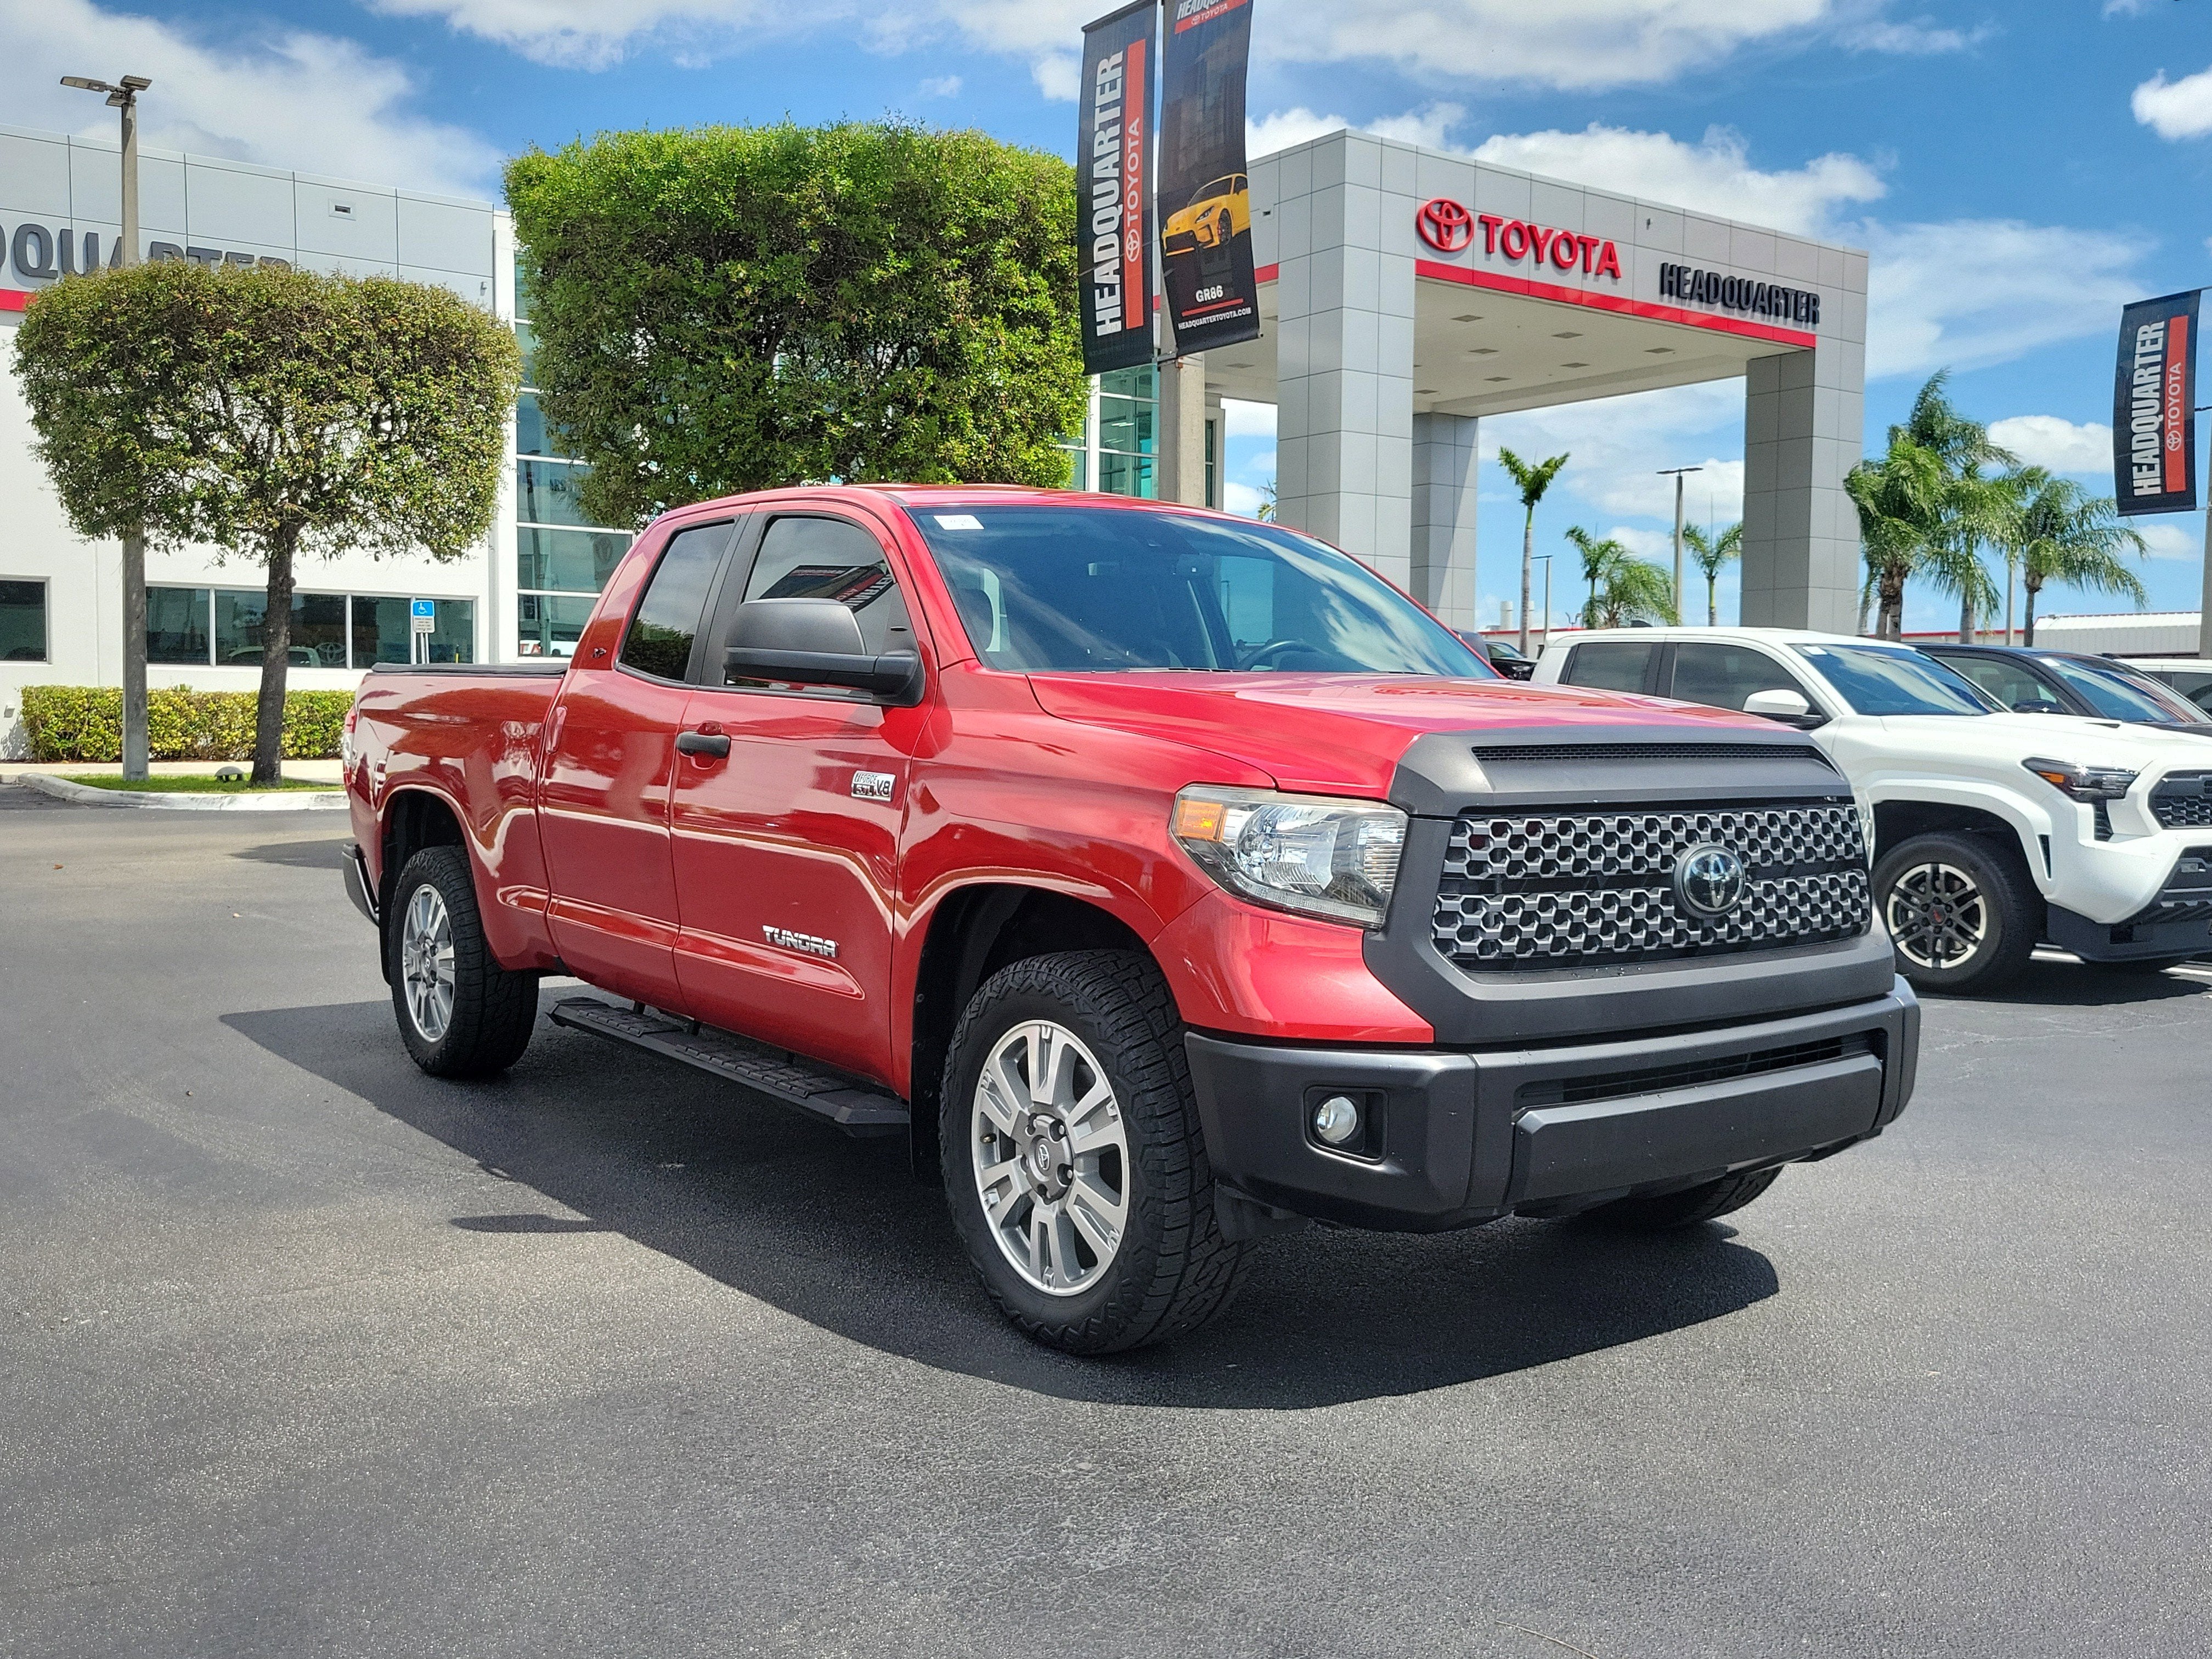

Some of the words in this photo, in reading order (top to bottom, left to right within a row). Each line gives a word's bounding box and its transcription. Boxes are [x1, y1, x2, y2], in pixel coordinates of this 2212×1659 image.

[1200, 3, 1228, 20] TOYOTA
[1092, 50, 1123, 336] HEADQUARTER
[1127, 117, 1139, 228] TOYOTA
[1479, 215, 1621, 279] TOYOTA
[1178, 307, 1252, 330] HEADQUARTERTOYOTA.COM
[1195, 285, 1223, 302] GR86
[1660, 262, 1820, 324] HEADQUARTER
[2131, 321, 2165, 496] HEADQUARTER
[2168, 362, 2181, 430] TOYOTA
[876, 780, 890, 796] V8
[762, 924, 837, 958] TUNDRA
